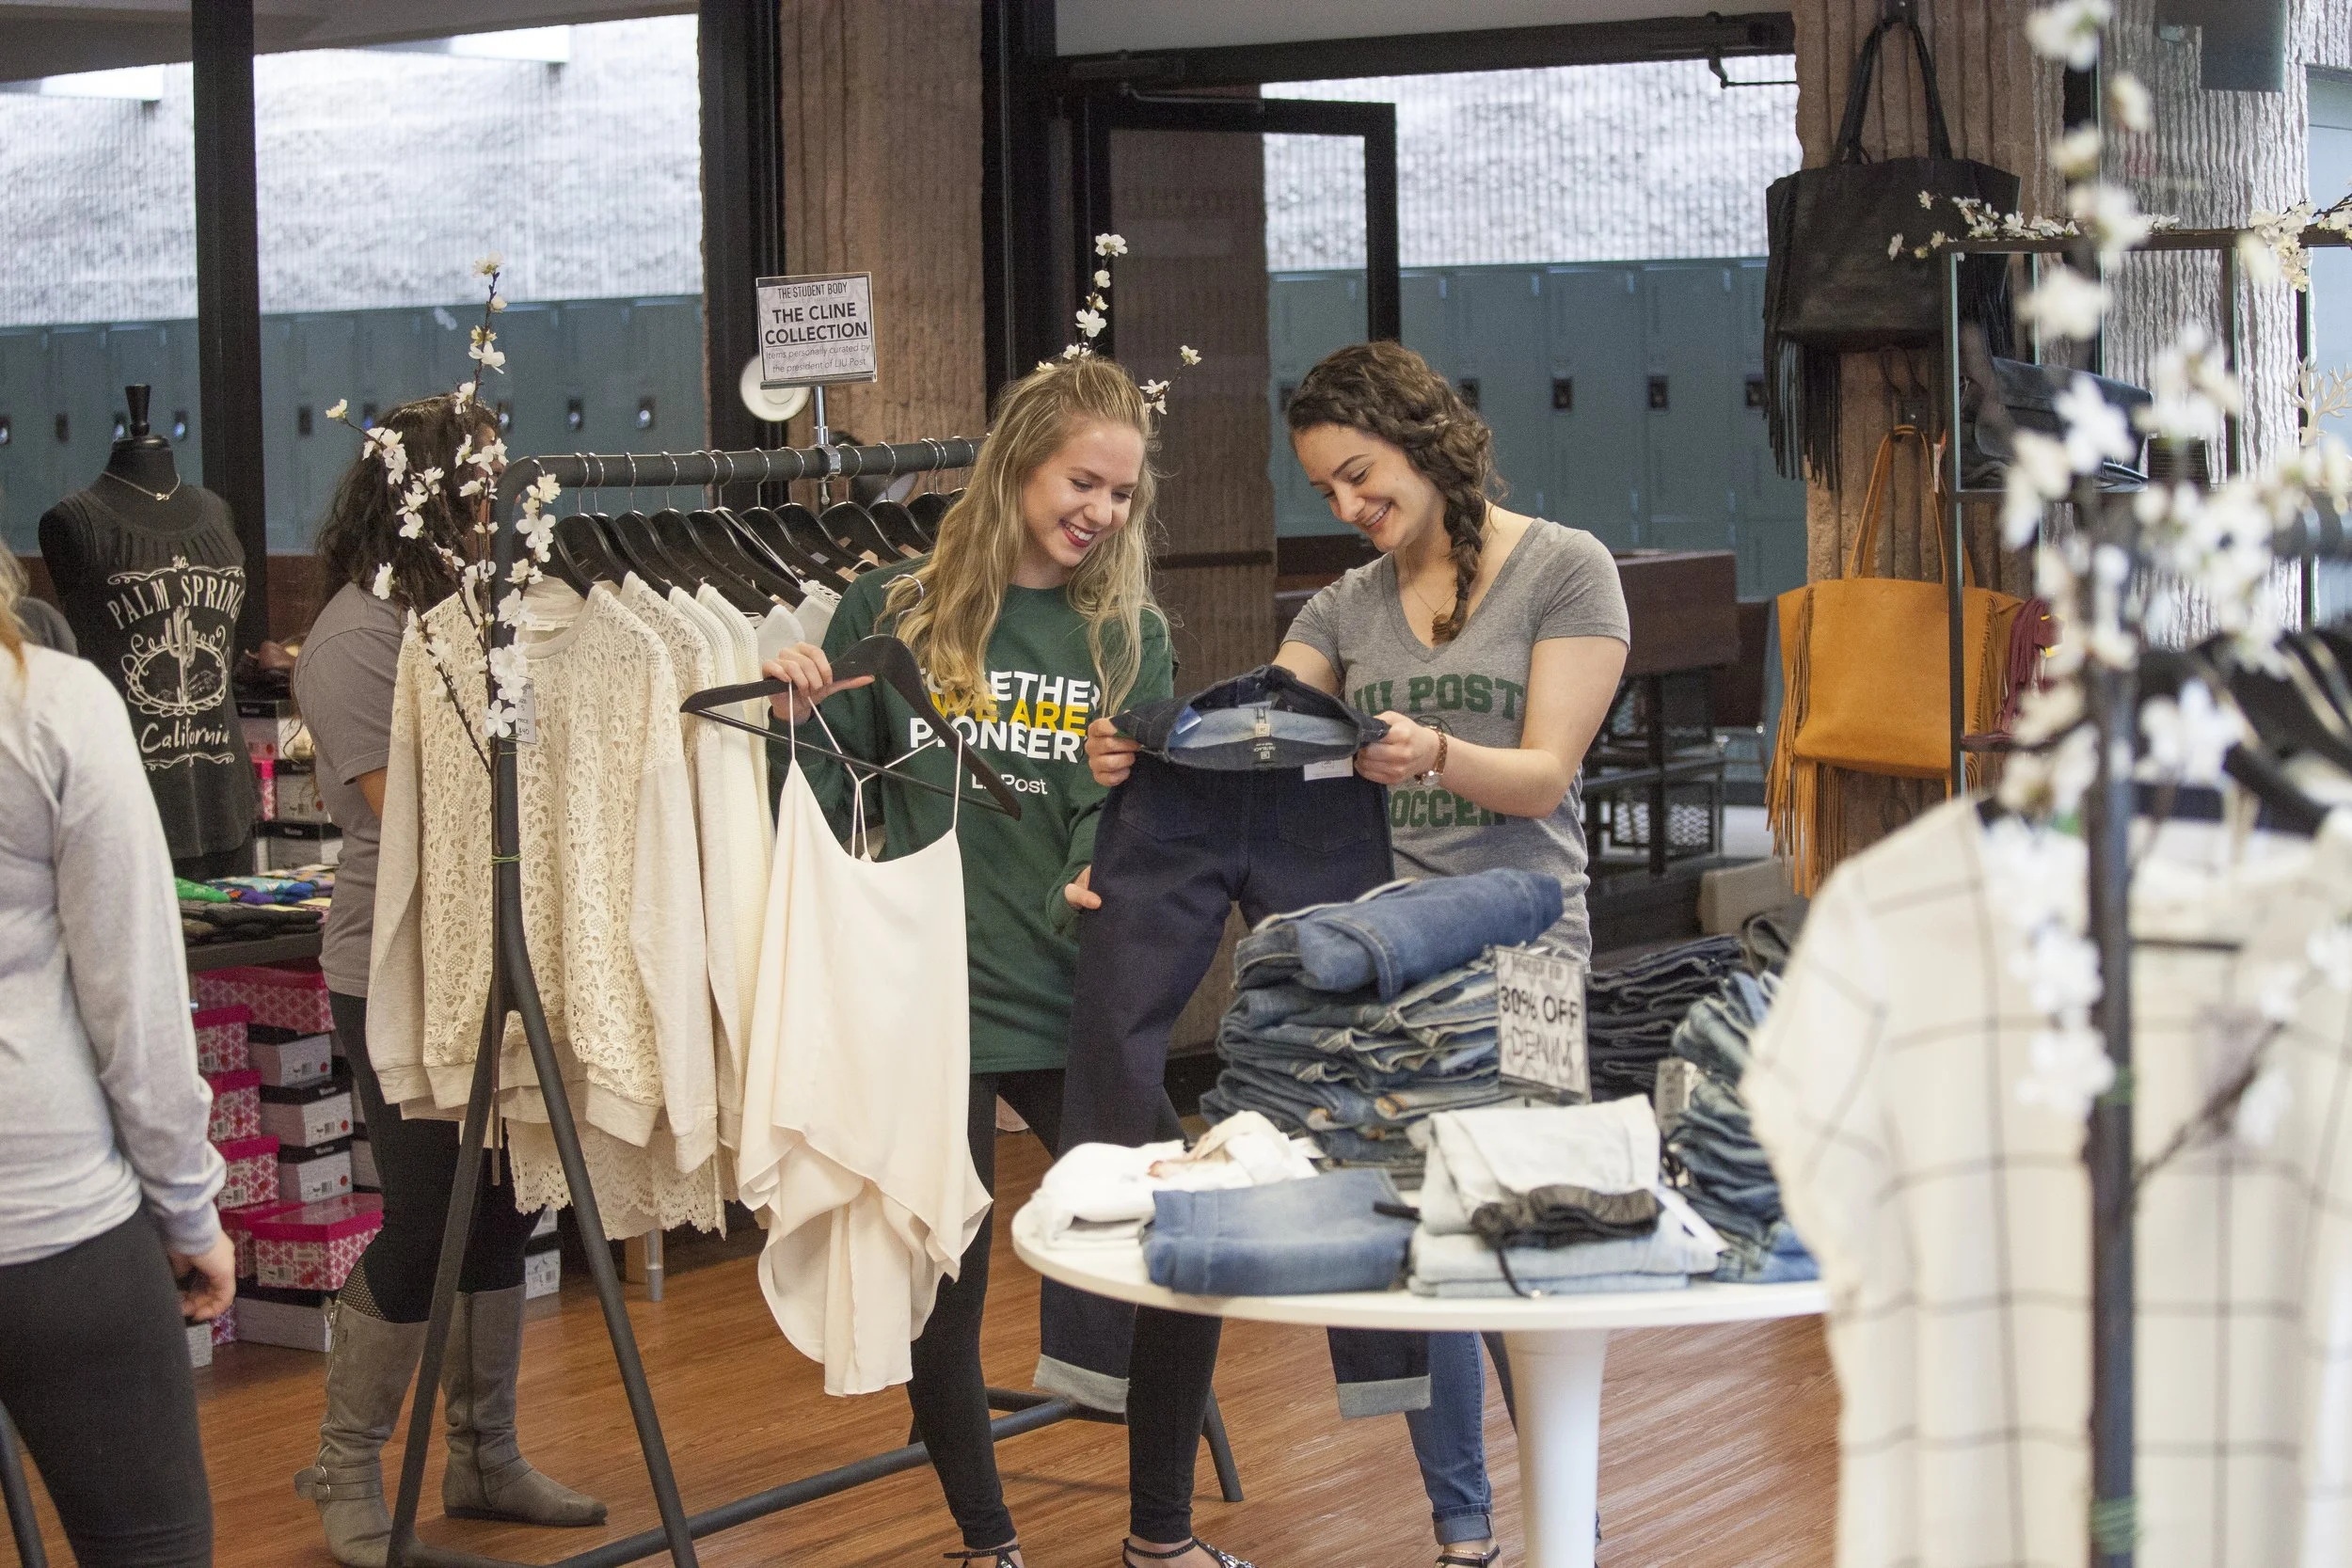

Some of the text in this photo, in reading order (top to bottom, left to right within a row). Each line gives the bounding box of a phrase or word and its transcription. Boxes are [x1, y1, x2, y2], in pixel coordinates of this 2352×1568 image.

[778, 282, 847, 299] THE STUDENT BODY
[772, 302, 856, 324] THE CLINE
[765, 322, 867, 345] COLLECTION
[766, 342, 870, 359] Items personally curated by
[787, 361, 823, 373] president
[824, 358, 834, 369] of
[834, 357, 848, 368] LIU
[849, 357, 866, 367] Post
[106, 578, 170, 630] PALM
[1408, 673, 1524, 721] POST
[140, 718, 230, 752] California
[1009, 698, 1089, 737] ARE
[910, 716, 1088, 764] PONEER
[1389, 789, 1508, 828] OCCE
[1501, 986, 1579, 1028] 30% OFF
